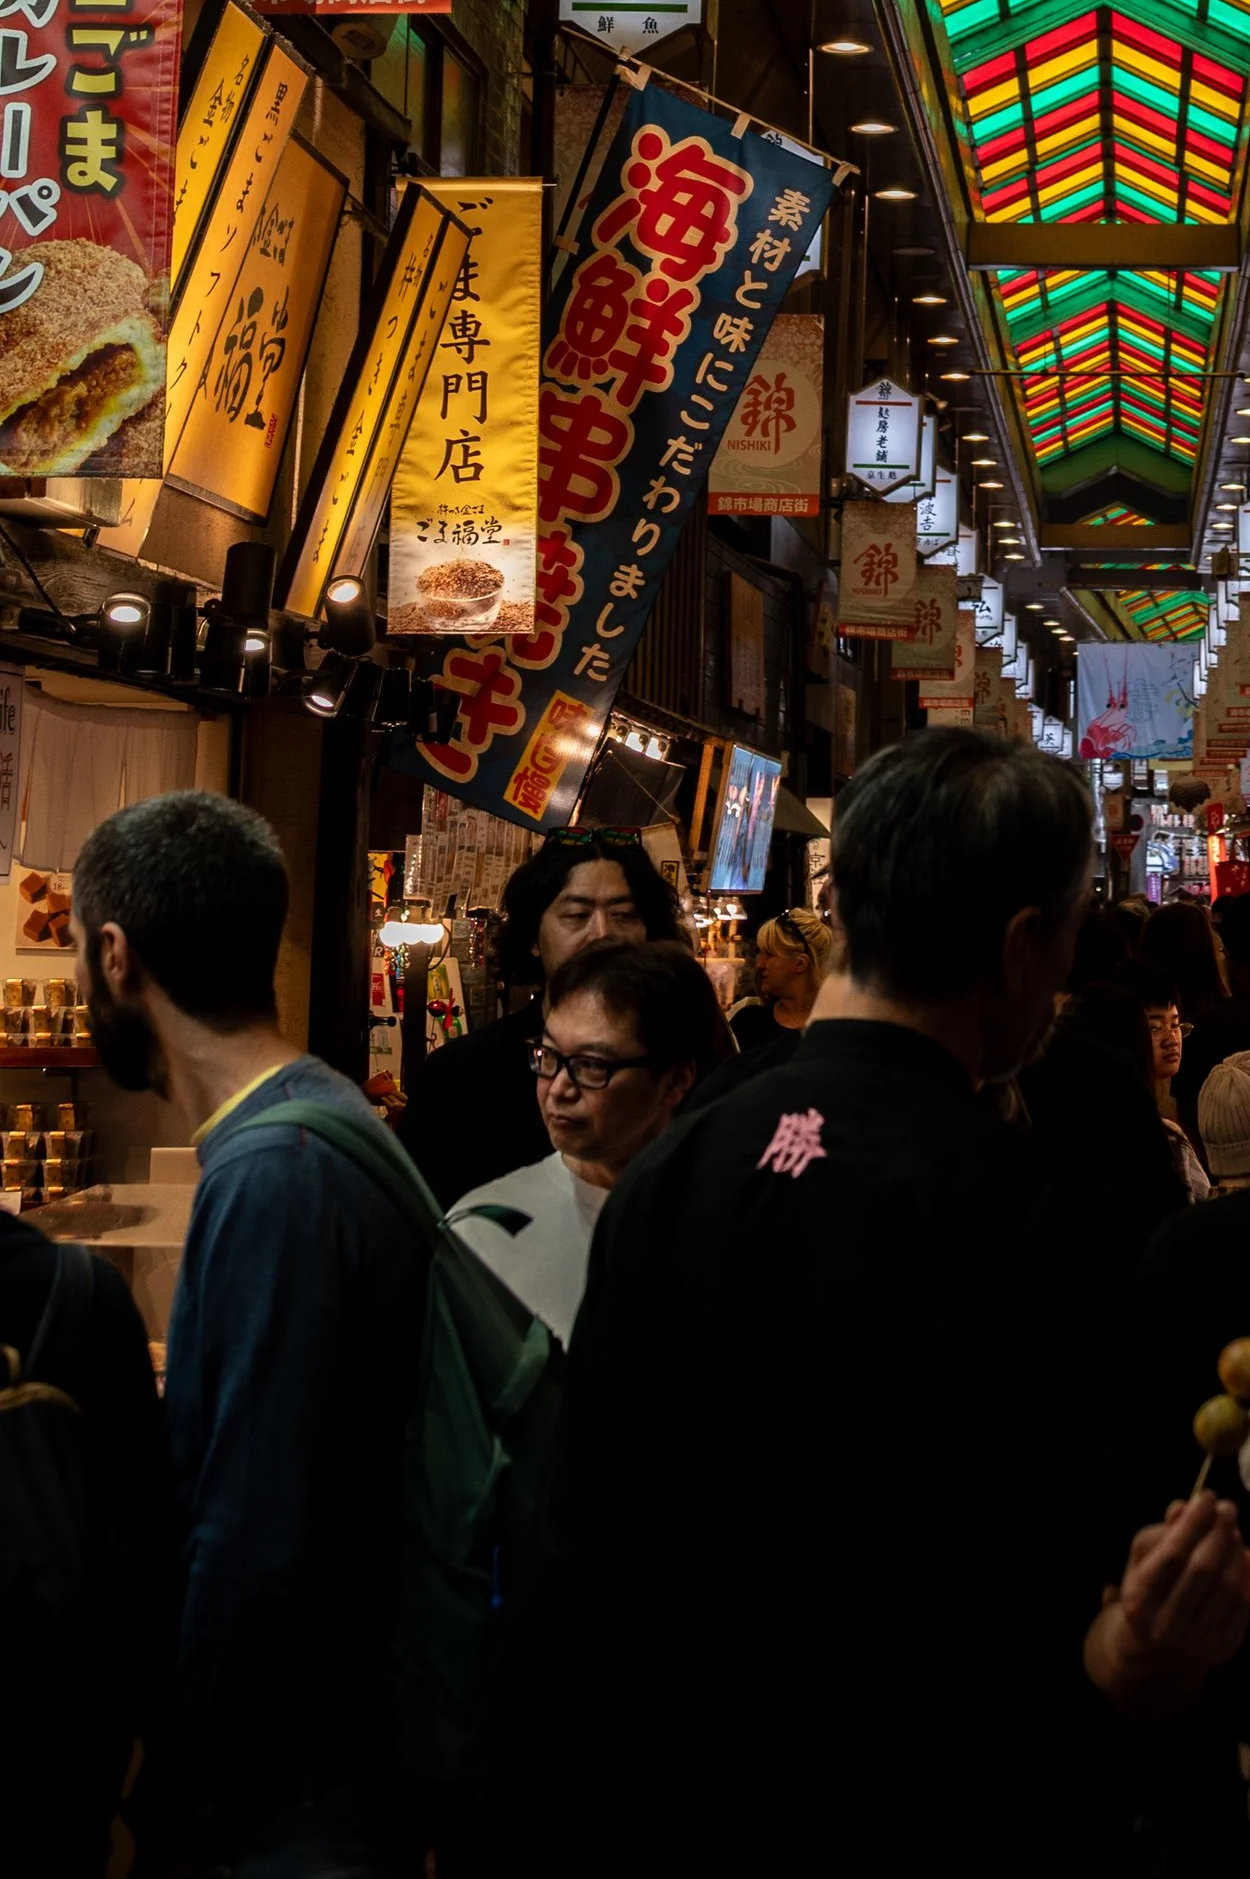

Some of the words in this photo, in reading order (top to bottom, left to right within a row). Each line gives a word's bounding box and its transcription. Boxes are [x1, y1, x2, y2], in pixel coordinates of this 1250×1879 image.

[596, 14, 660, 35] 鮮魚
[434, 196, 496, 484] ごま専門店
[740, 371, 797, 456] 錦
[573, 188, 811, 683] 素材と味にこだわりました
[727, 438, 771, 452] NISHIKI
[716, 495, 810, 514] 錦市場商店街
[416, 515, 502, 546] ごま福堂
[852, 542, 899, 598] 錦
